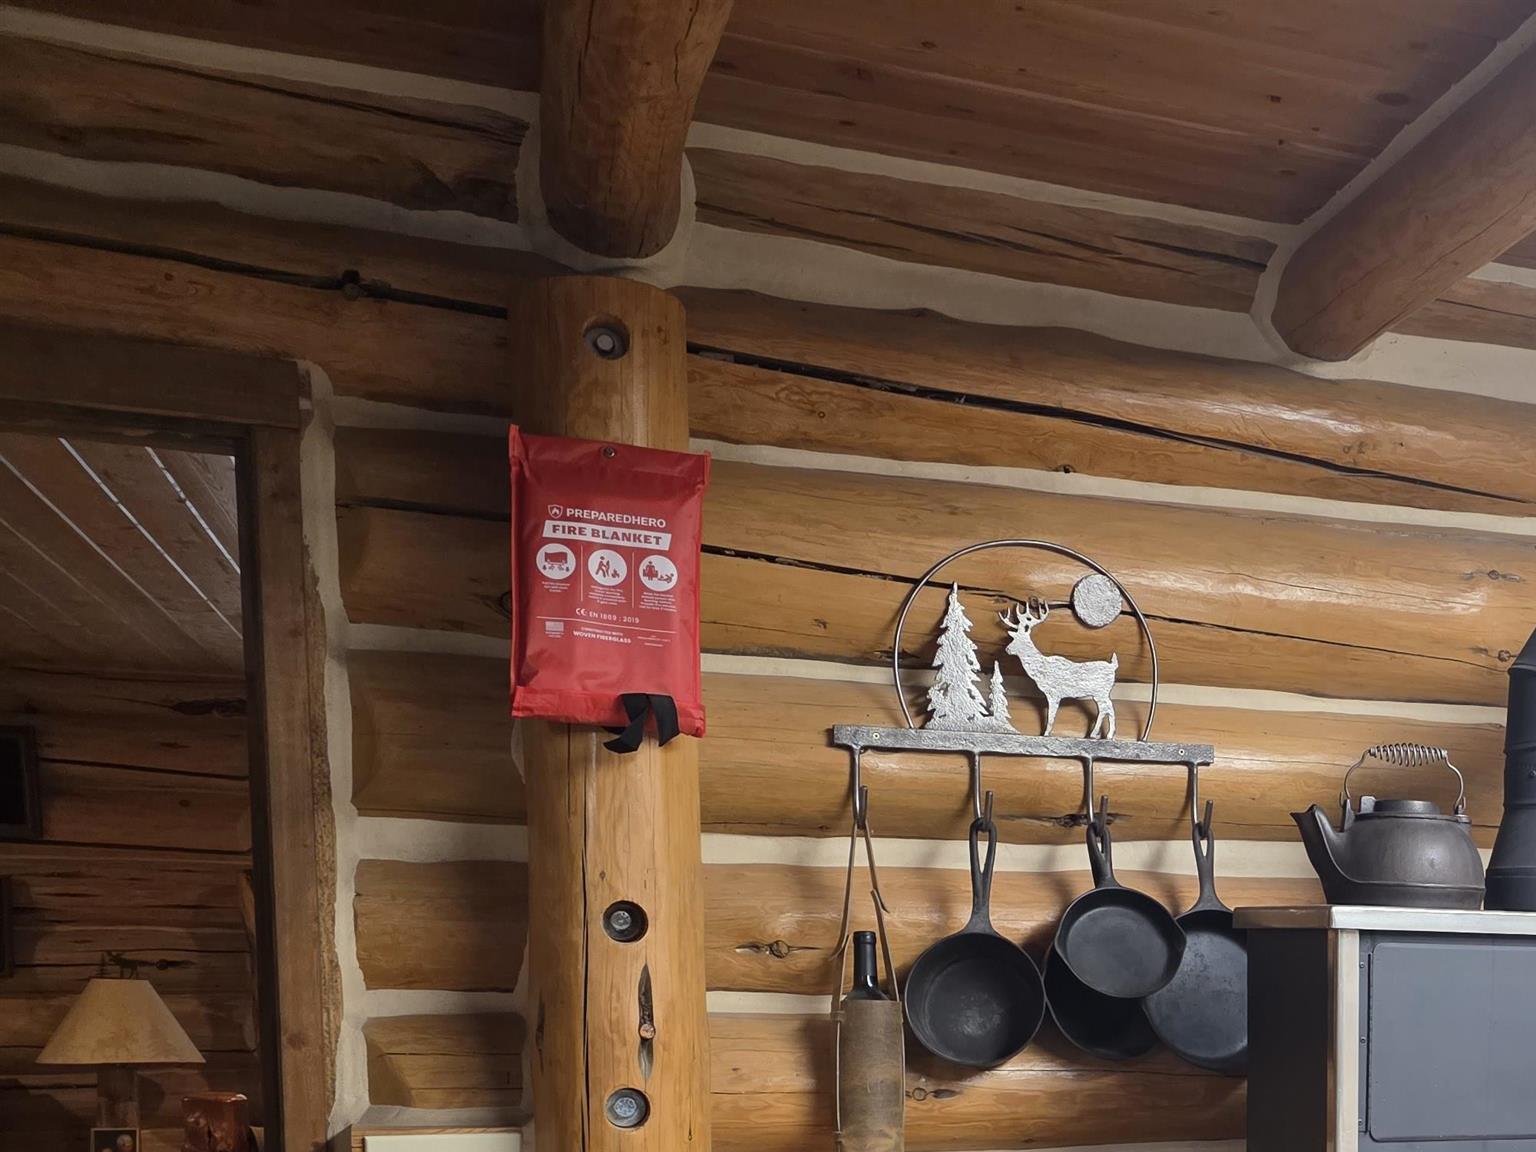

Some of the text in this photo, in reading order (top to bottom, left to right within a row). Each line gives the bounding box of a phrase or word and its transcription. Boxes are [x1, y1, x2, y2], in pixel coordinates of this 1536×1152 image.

[566, 508, 667, 528] PREPAREDHERO
[552, 524, 662, 546] FIRE BLANKET
